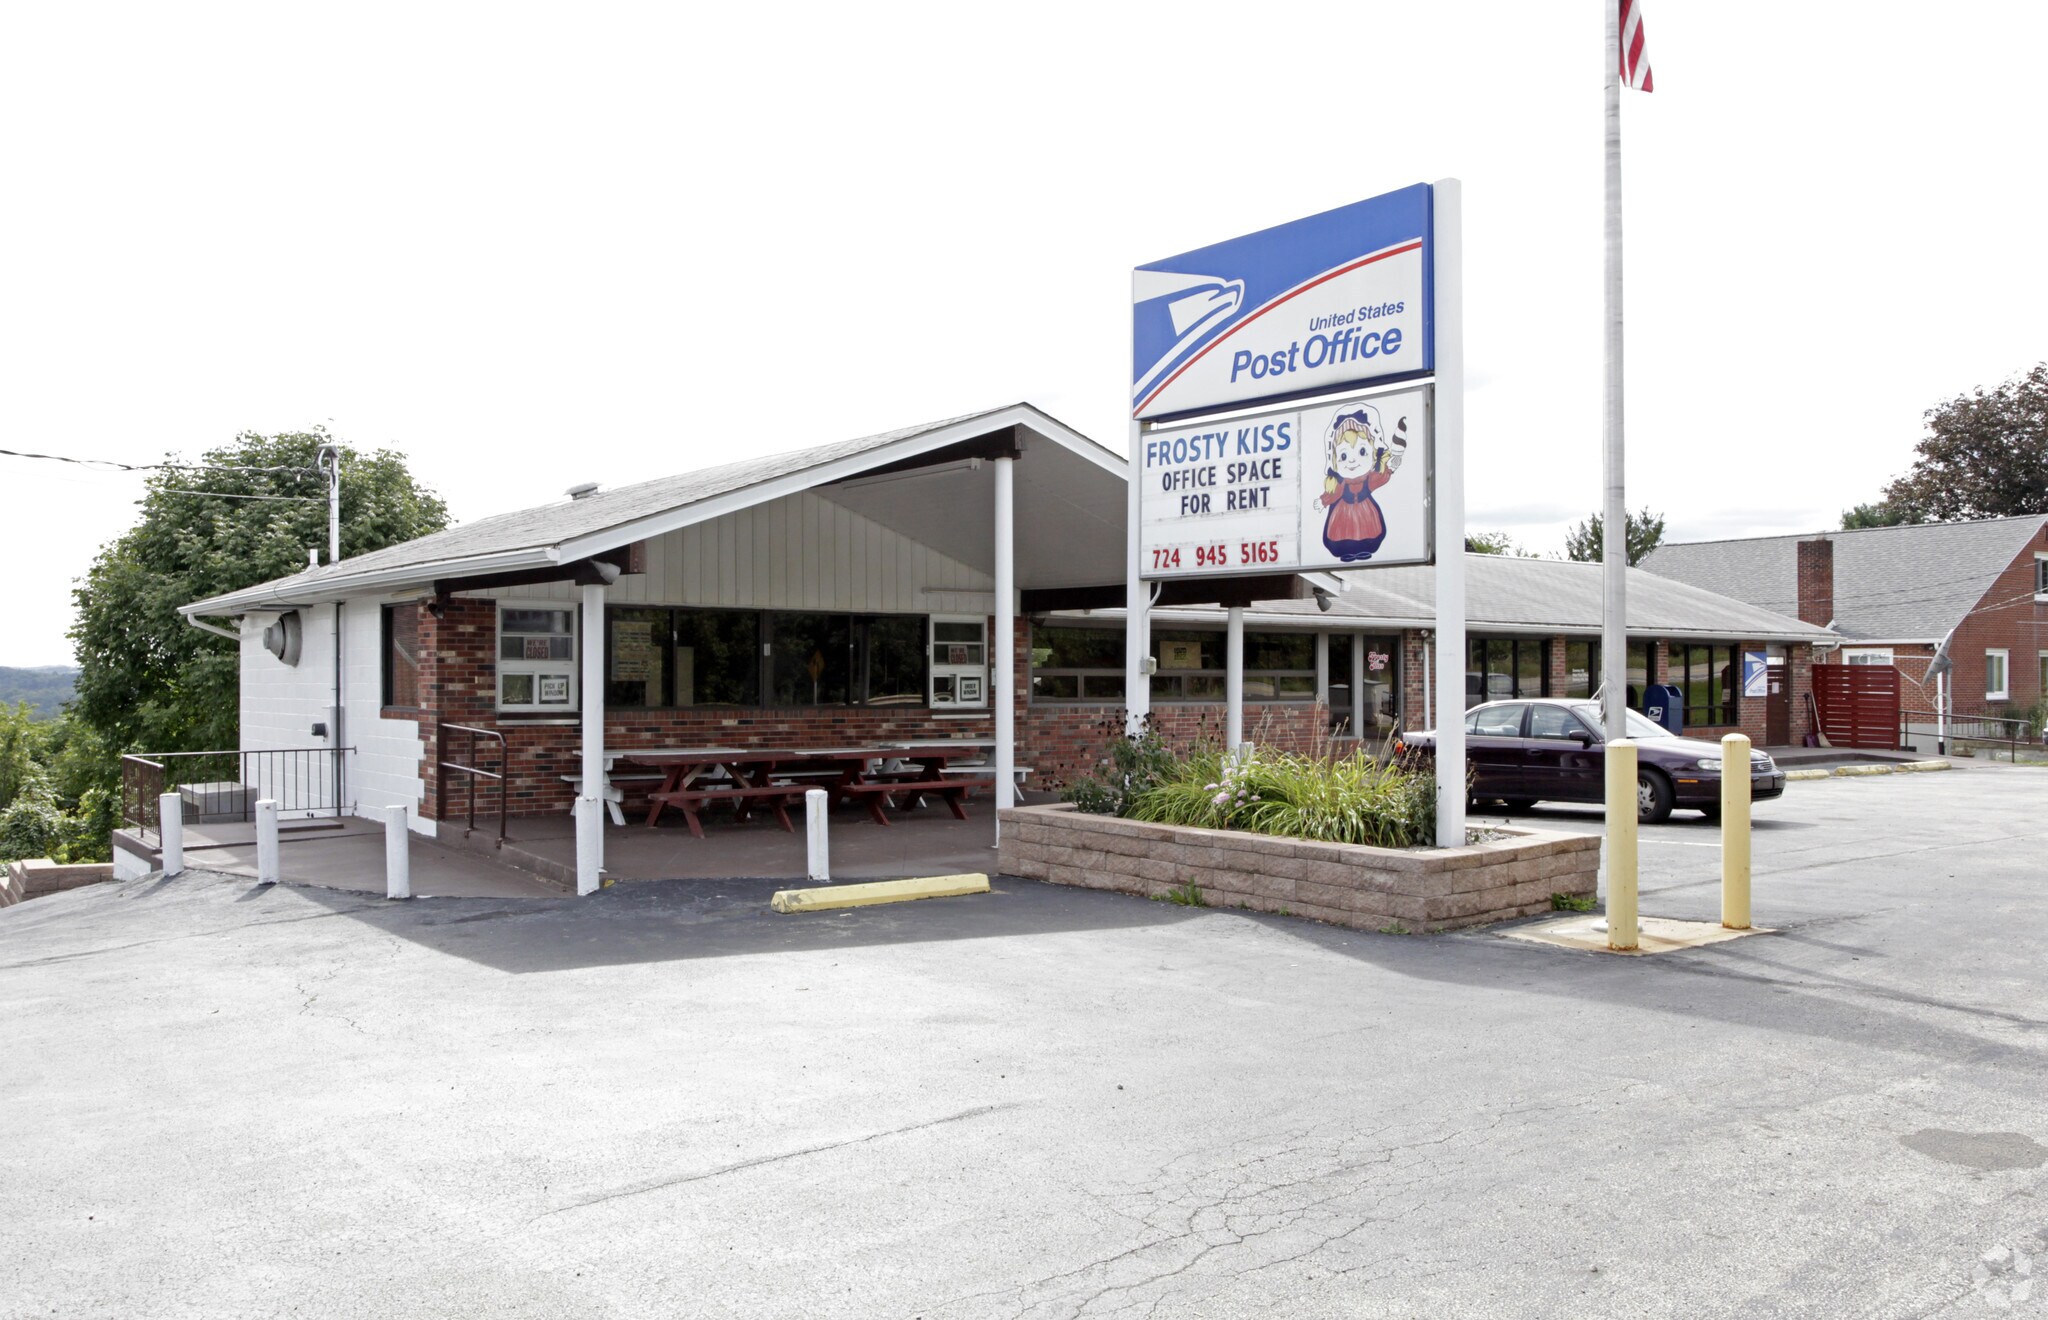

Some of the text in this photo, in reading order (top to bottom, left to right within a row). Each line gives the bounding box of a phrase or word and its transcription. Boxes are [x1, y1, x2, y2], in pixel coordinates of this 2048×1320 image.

[1309, 301, 1404, 332] United States
[1230, 326, 1402, 383] Post Office
[1146, 422, 1291, 468] FROSTY KISS
[1162, 457, 1282, 492] OFFICE SPACE
[1181, 487, 1270, 516] FOR RENT
[1152, 541, 1279, 569] 724 945 5165
[525, 647, 549, 659] CLOSED
